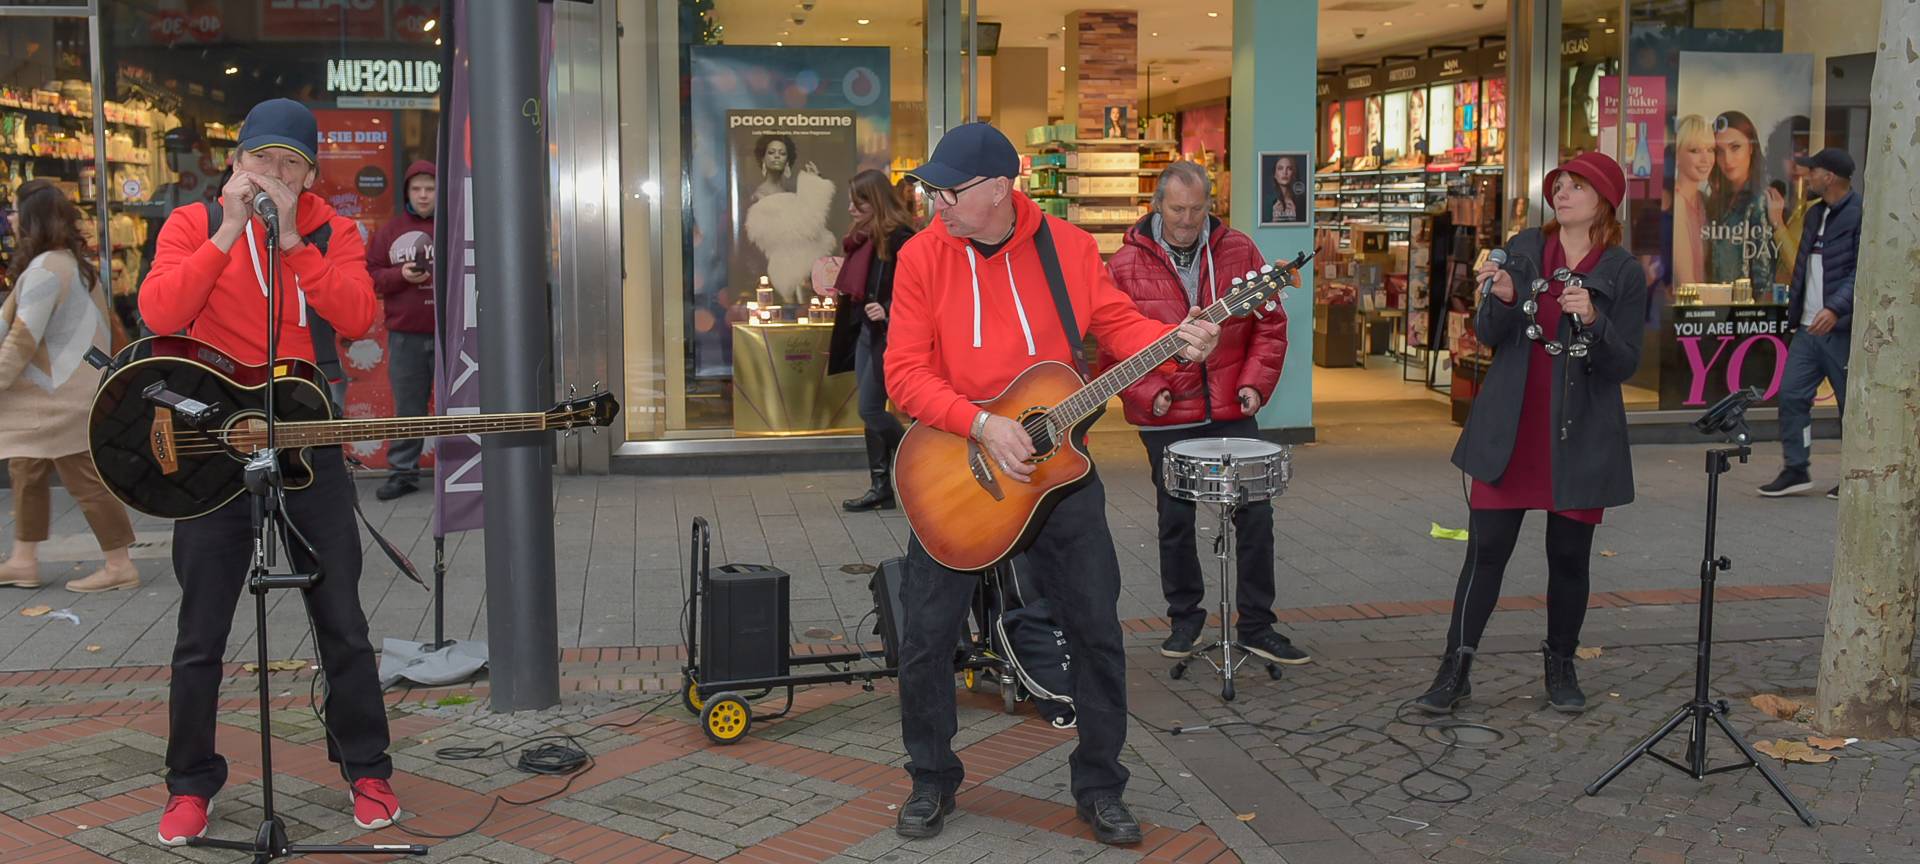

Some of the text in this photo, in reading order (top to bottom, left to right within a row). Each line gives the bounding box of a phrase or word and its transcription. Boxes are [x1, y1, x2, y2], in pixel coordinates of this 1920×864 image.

[730, 114, 852, 128] paco rabanne
[327, 131, 353, 143] SIE
[354, 131, 388, 143] DIR!
[1700, 219, 1773, 246] singles
[1742, 240, 1783, 260] DAY
[1674, 322, 1703, 336] YOU
[1706, 321, 1733, 335] ARE
[1737, 320, 1778, 334] MADE
